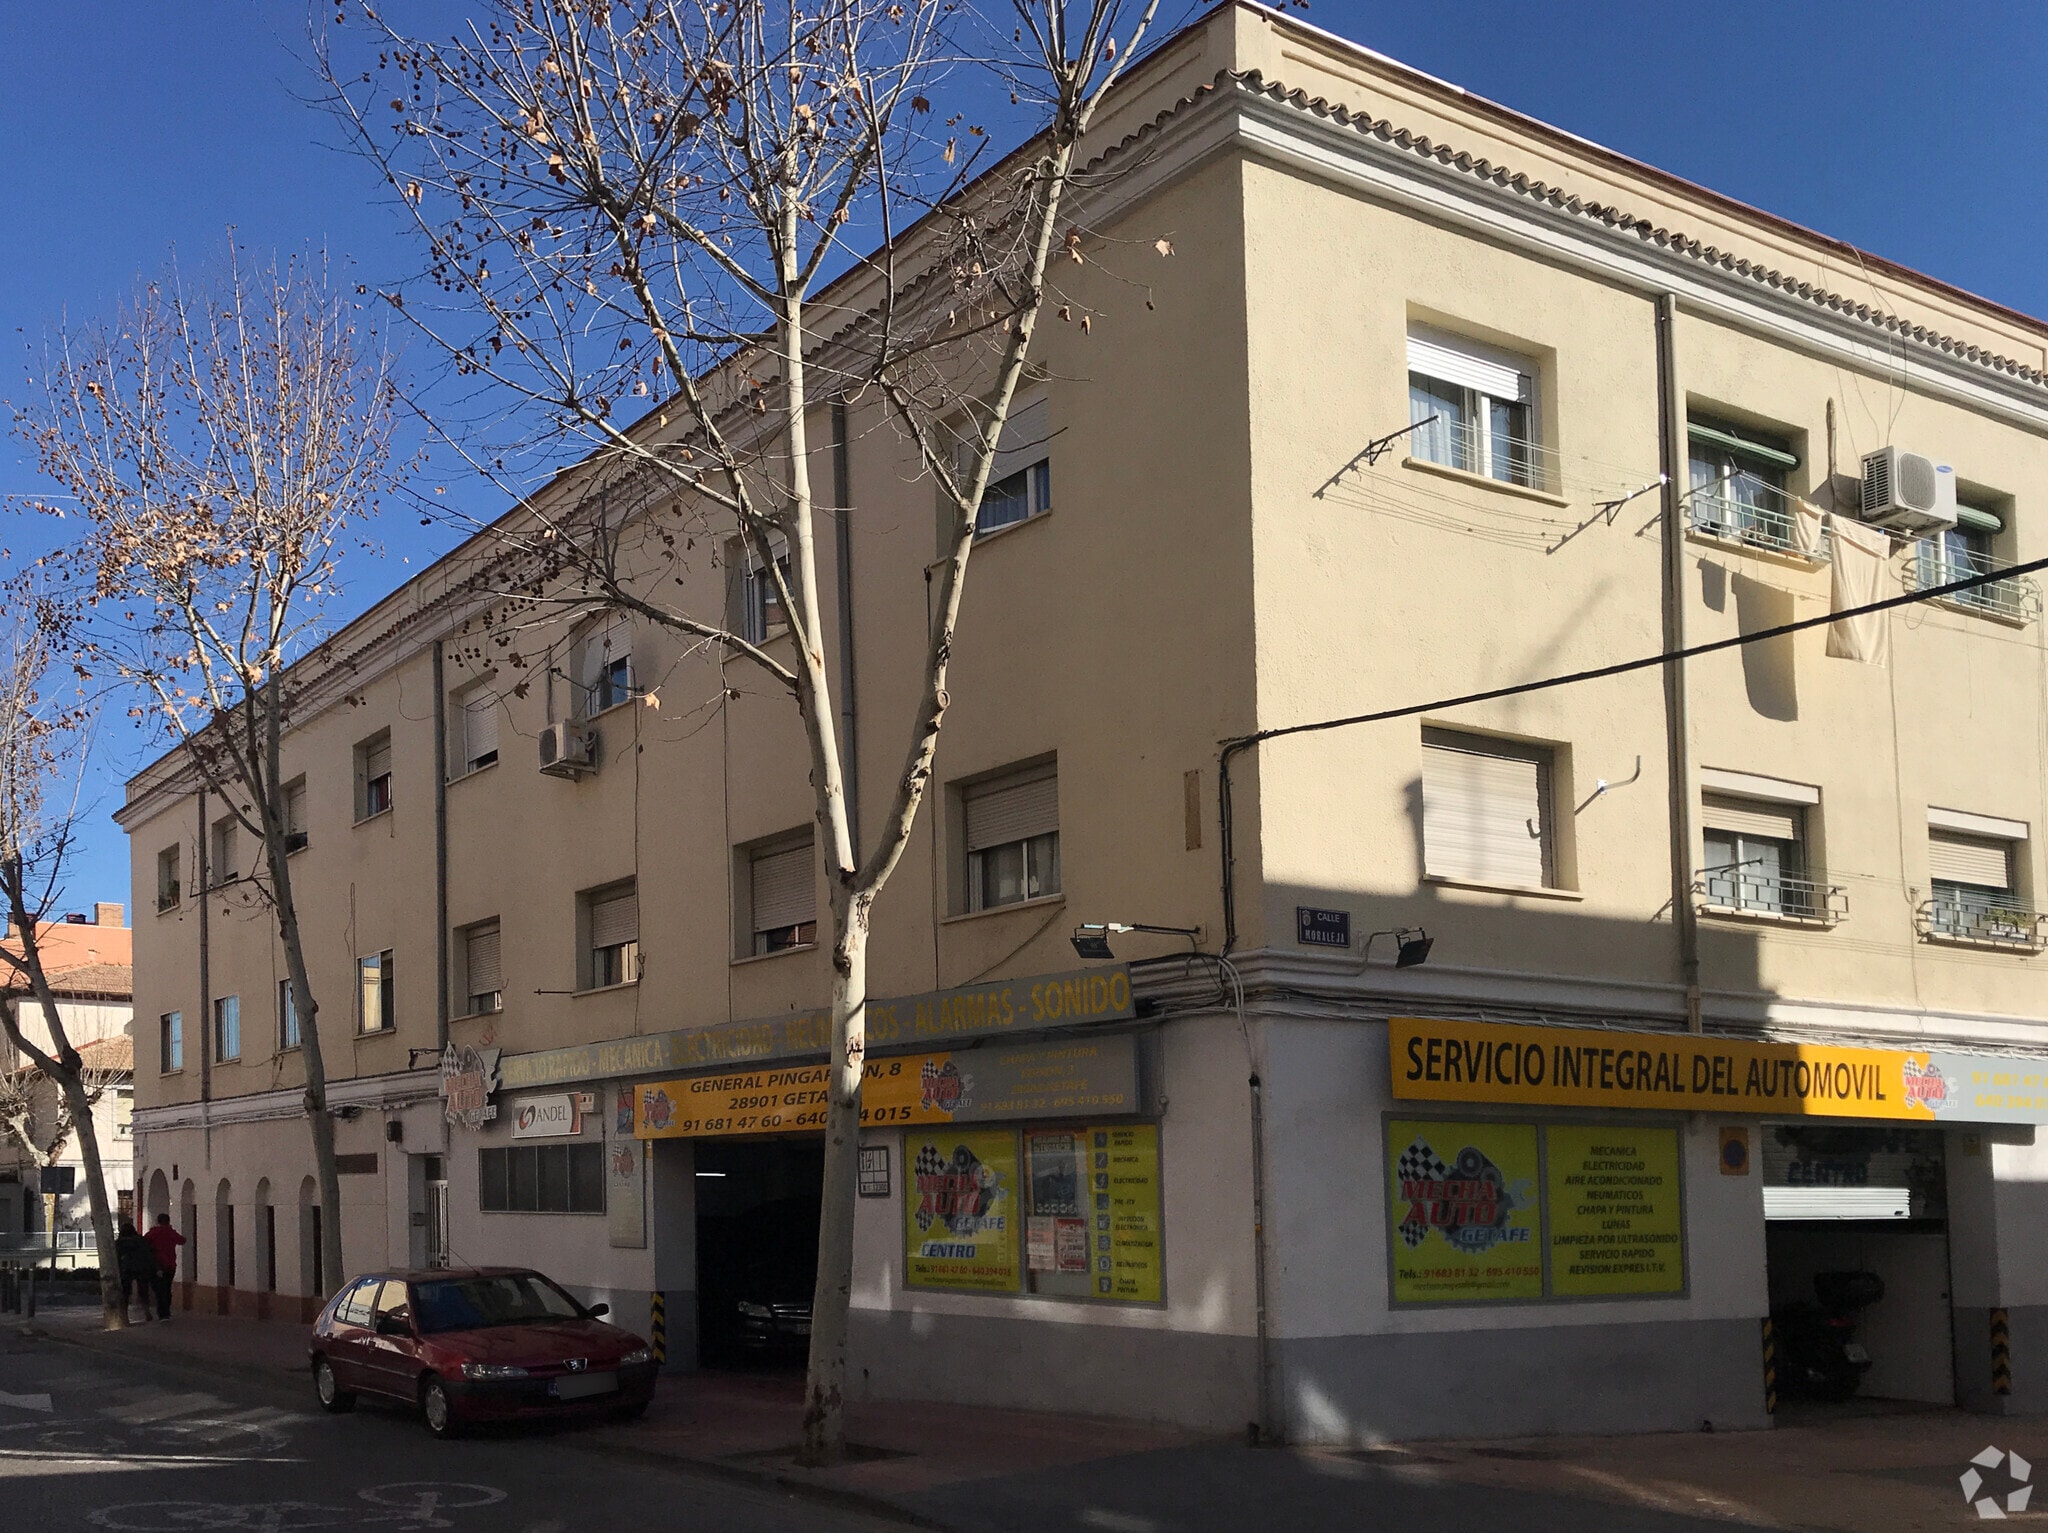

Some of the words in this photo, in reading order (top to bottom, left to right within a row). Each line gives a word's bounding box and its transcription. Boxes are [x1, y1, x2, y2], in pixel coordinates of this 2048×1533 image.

[1317, 912, 1340, 923] CALLE
[1305, 929, 1345, 943] MORALEJA
[599, 1039, 664, 1072] MECANICA
[671, 1024, 773, 1065] ELECTRICIDAD
[916, 987, 1014, 1035] ALARMAS
[1031, 972, 1130, 1021] SONIDO
[1406, 1036, 1545, 1086] SERVICIO
[1552, 1046, 1685, 1093] INTEGRAL
[1692, 1055, 1738, 1095] DEL
[1745, 1058, 1887, 1101] AUTOMOVIL
[690, 1077, 763, 1093] GENERAL
[889, 1063, 901, 1076] 8
[1908, 1086, 1944, 1099] AUTO
[728, 1094, 778, 1110] 28901
[536, 1105, 567, 1122] ANDEL
[683, 1119, 700, 1131] 91
[705, 1117, 732, 1131] 681
[737, 1116, 757, 1129] 47
[761, 1114, 781, 1128] 60
[874, 1106, 911, 1121] 015
[1590, 1146, 1637, 1157] MECANICA
[1582, 1161, 1645, 1171] ELECTRICIDAD
[1788, 1161, 1868, 1185] CENTRO
[1565, 1175, 1586, 1185] AIRE
[1588, 1175, 1663, 1186] ACONDICIONADO
[1402, 1180, 1494, 1200] MECHA
[1587, 1190, 1644, 1200] NEUMATICOS
[919, 1192, 980, 1214] AUTO
[1577, 1205, 1606, 1215] CHAPA
[1609, 1205, 1614, 1214] Y
[1616, 1204, 1654, 1215] PINTURA
[1404, 1201, 1497, 1225] AUTO
[1602, 1220, 1631, 1230] LUNAS
[1461, 1228, 1530, 1242] GETAFE
[1553, 1235, 1595, 1245] LIMPIEZA
[1597, 1235, 1615, 1244] POR
[1617, 1234, 1678, 1244] ULTRASONIDO
[922, 1243, 976, 1258] CENTRO
[1579, 1249, 1620, 1260] SERVICIO
[1621, 1248, 1655, 1259] RAPIDO
[1569, 1264, 1612, 1275] REVISION
[1613, 1263, 1645, 1274] EXPRES
